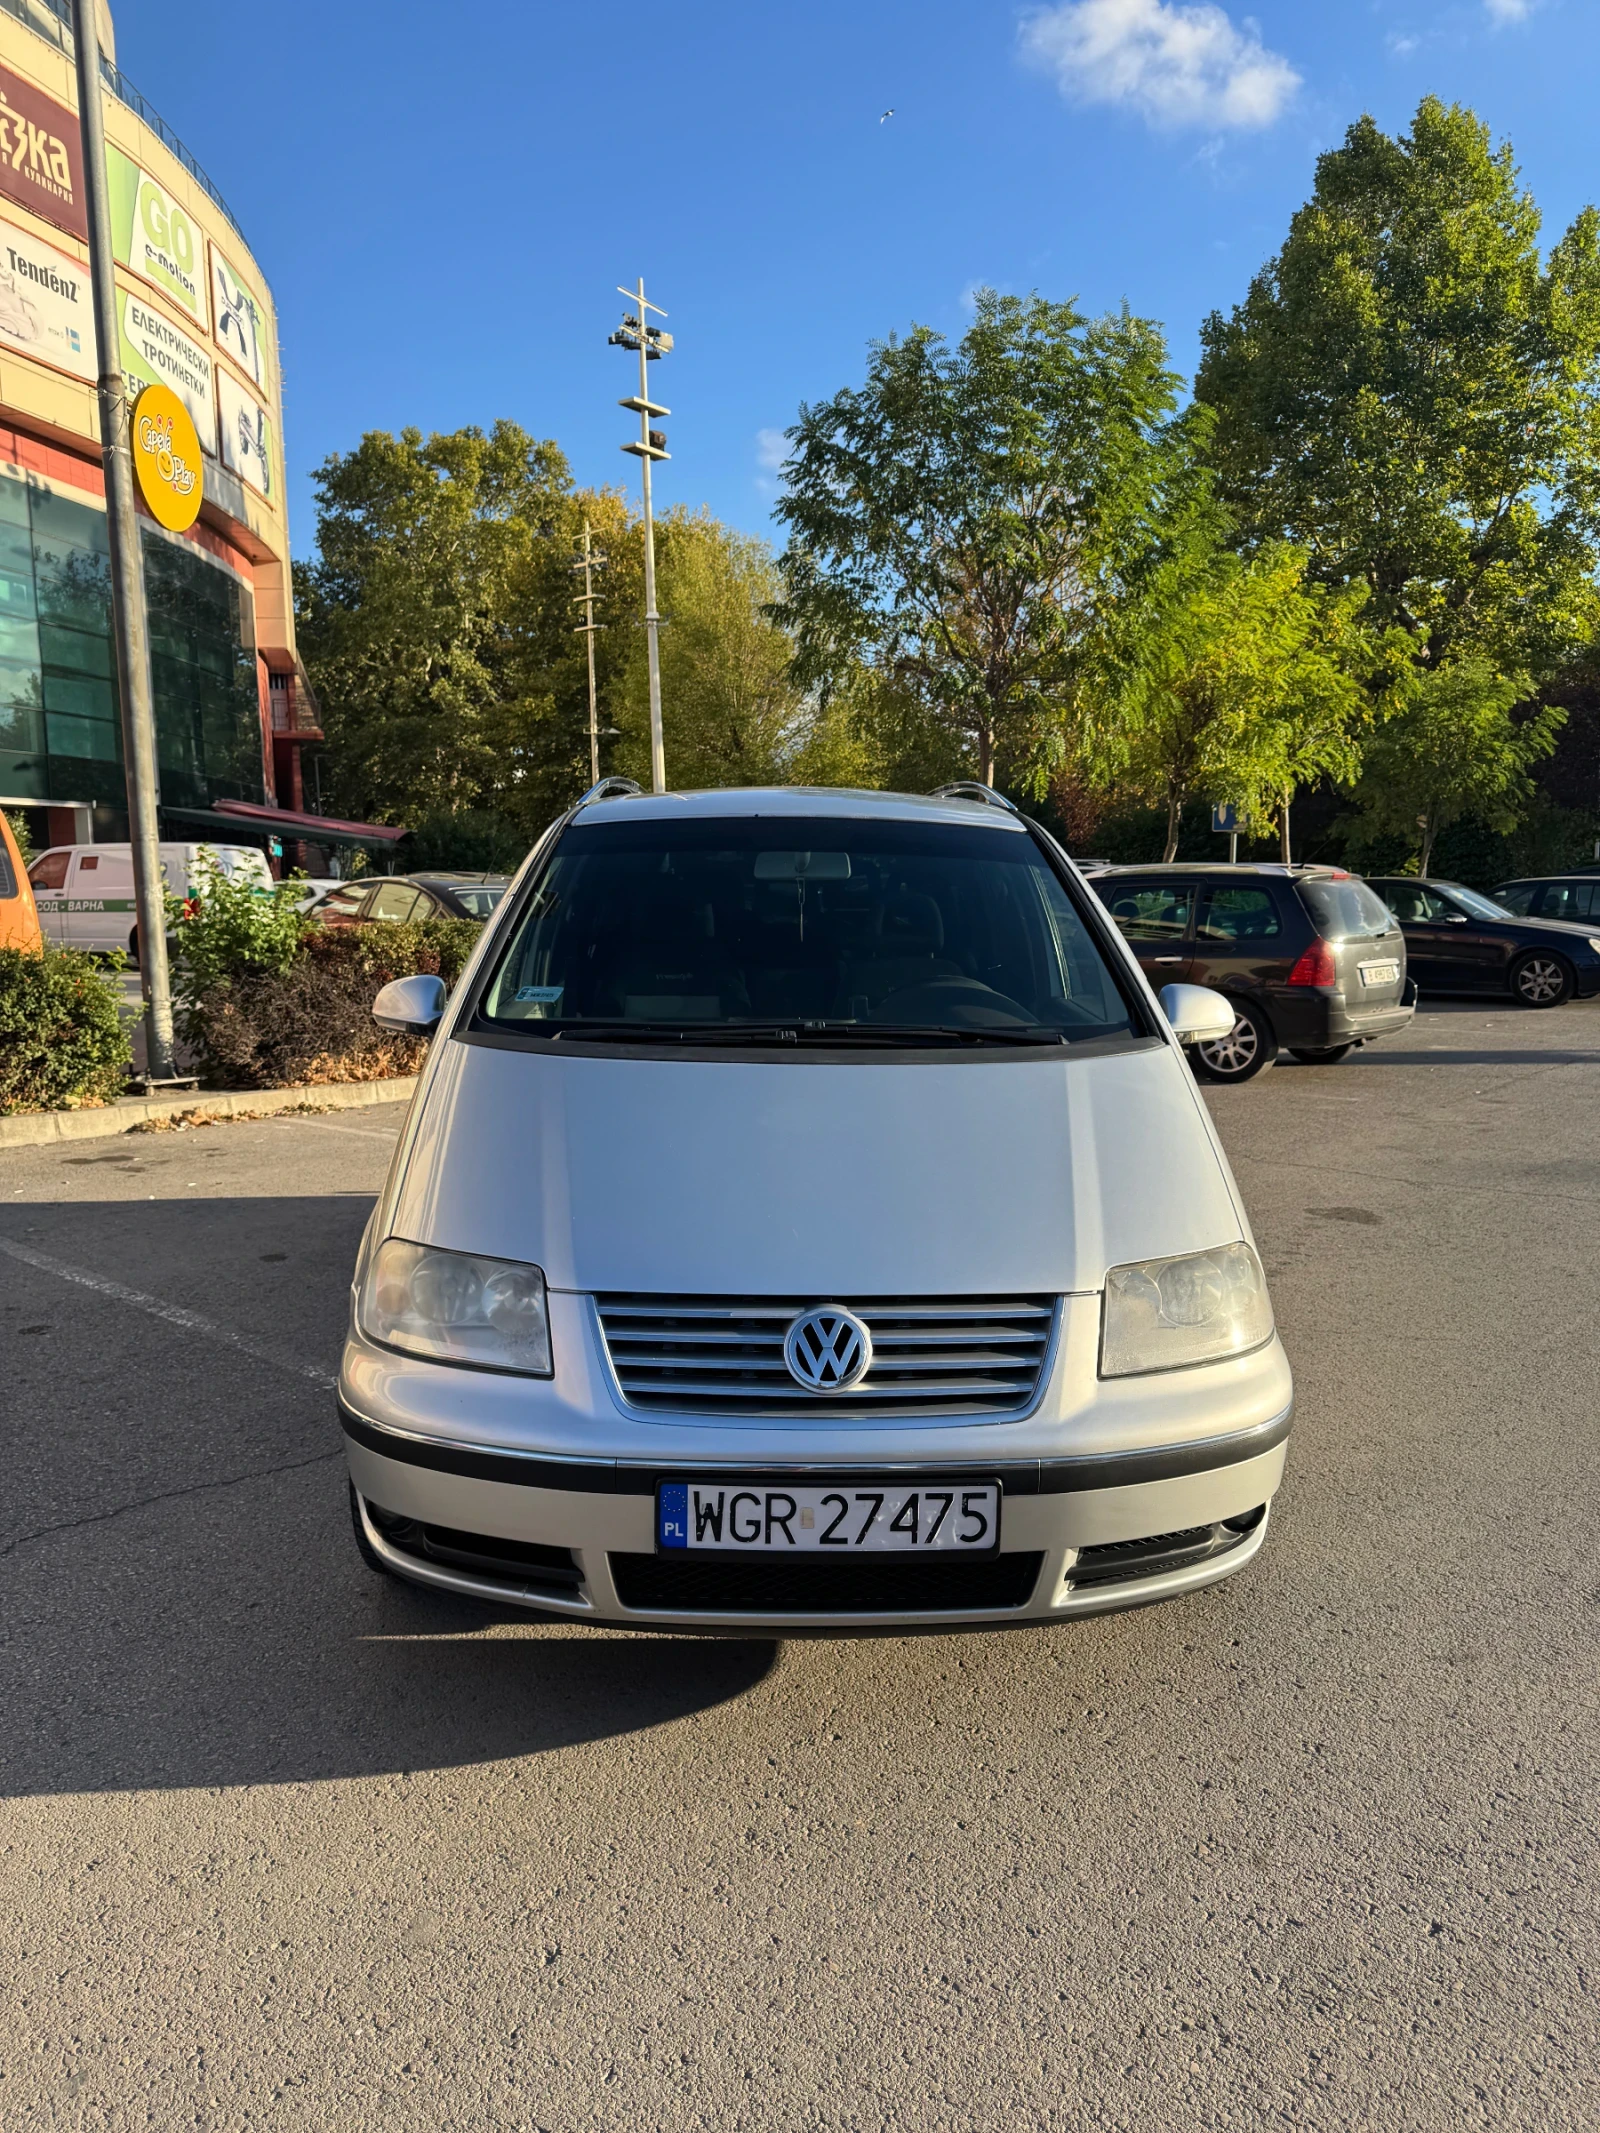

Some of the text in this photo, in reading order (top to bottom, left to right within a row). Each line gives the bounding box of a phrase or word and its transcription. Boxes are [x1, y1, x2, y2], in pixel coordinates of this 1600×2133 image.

[24, 165, 73, 205] КУЛИНАРИЯ
[140, 181, 194, 274] GO
[145, 244, 196, 296] e-motion
[132, 306, 209, 379] ЕЛЕКТРИЧЕСКИ
[142, 339, 205, 399] ТРОТИНЕТКИ
[139, 414, 173, 454] Capella
[172, 455, 197, 496] Play
[68, 901, 105, 911] ВАРНА
[794, 1315, 862, 1387] VW
[664, 1522, 684, 1537] PL
[693, 1491, 988, 1545] WGR 27475
